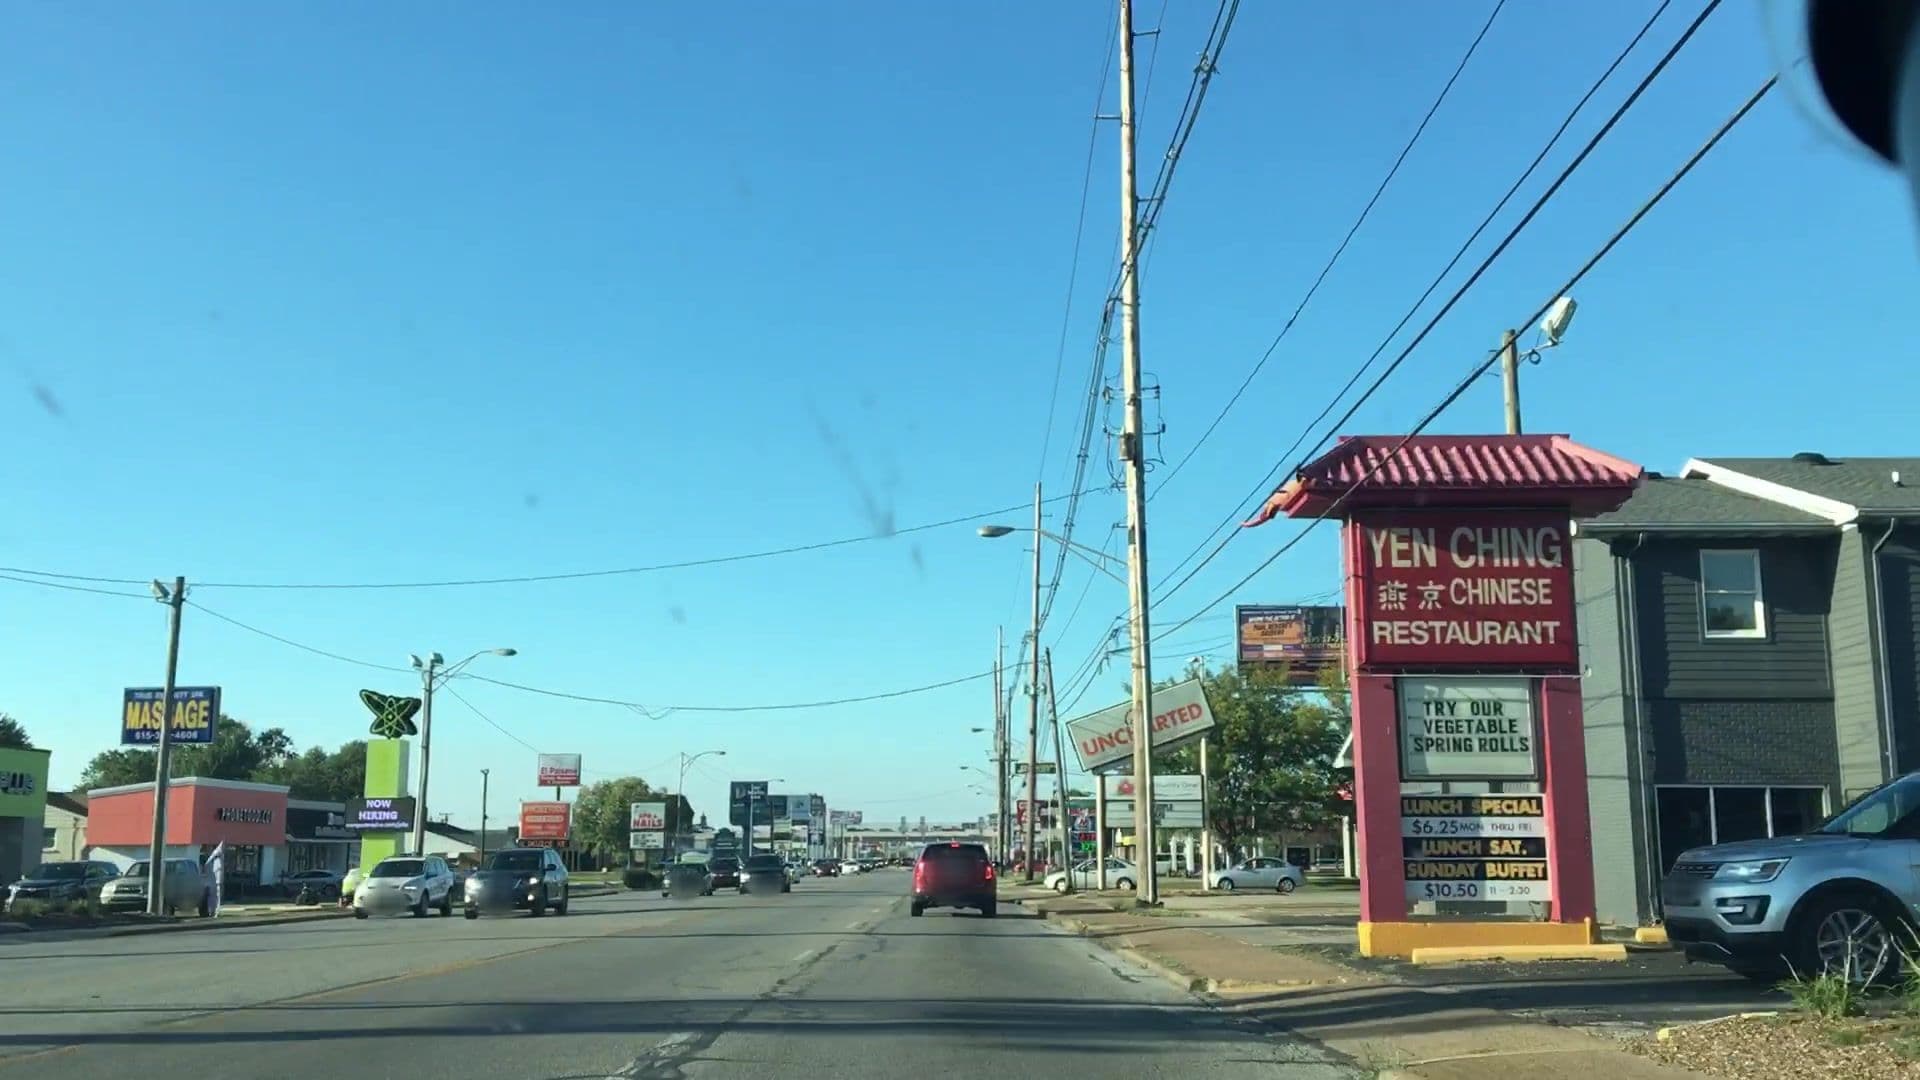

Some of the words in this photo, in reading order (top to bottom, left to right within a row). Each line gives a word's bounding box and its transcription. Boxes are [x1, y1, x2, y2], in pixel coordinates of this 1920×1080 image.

[1367, 527, 1437, 568] YEN
[1450, 526, 1564, 568] CHING
[1450, 577, 1553, 605] CHINESE
[1372, 620, 1561, 645] RESTAURANT
[126, 700, 209, 729] MASAGE
[1423, 701, 1456, 716] TRY
[1470, 701, 1503, 716] OUR
[1423, 719, 1518, 734] VEGETABLE
[1413, 737, 1473, 752] SPRING
[1477, 737, 1530, 752] ROLLS
[366, 799, 392, 809] NOW
[1403, 799, 1464, 814] LUNCH
[1471, 799, 1541, 814] SPECIAL
[358, 810, 398, 821] HIRING
[1412, 819, 1458, 835] $6.25
[1459, 824, 1484, 832] MON
[1490, 823, 1515, 832] THRU
[1518, 824, 1532, 832] FRI
[1421, 840, 1482, 855] LUNCH
[1489, 839, 1528, 856] SAT.
[1407, 863, 1476, 878] SUNDAY
[1485, 862, 1545, 878] BUFFET
[1424, 882, 1478, 899] $10.50
